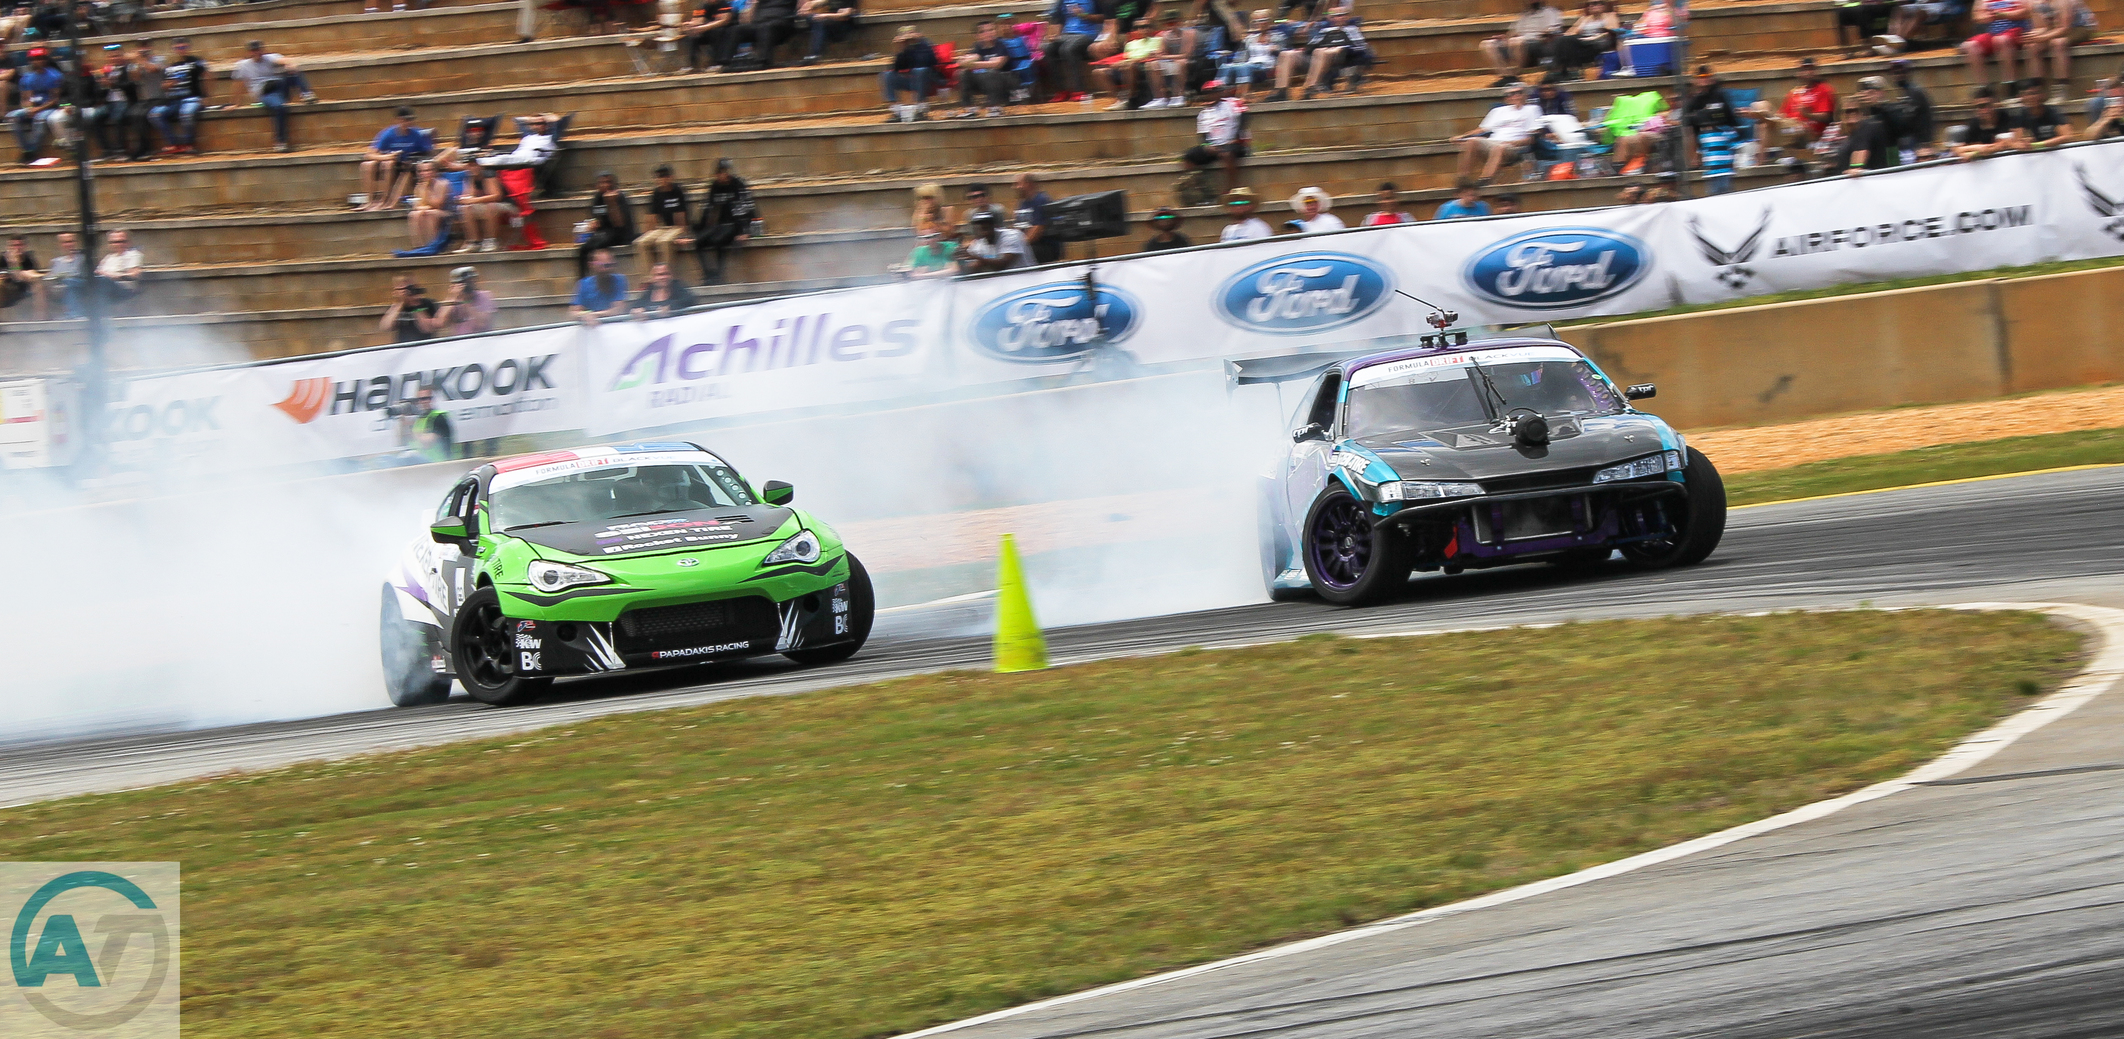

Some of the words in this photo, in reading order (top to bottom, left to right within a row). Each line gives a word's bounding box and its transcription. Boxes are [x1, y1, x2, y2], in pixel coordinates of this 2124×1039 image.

[1771, 203, 2035, 259] AIRFORCE.COM
[1496, 240, 1616, 298] Ford
[1246, 265, 1361, 323] Ford
[605, 312, 921, 392] Achilles
[1388, 361, 1430, 373] FORMULA
[1430, 355, 1464, 367] DRIFT
[536, 462, 576, 475] FORMULA
[576, 457, 609, 469] DRIFT
[621, 536, 683, 551] Rocket
[685, 532, 739, 543] Bunny
[626, 528, 688, 541] NEXEN
[689, 525, 733, 535] TIRE
[660, 645, 715, 659] PAPADAKIS
[715, 640, 750, 653] RACING
